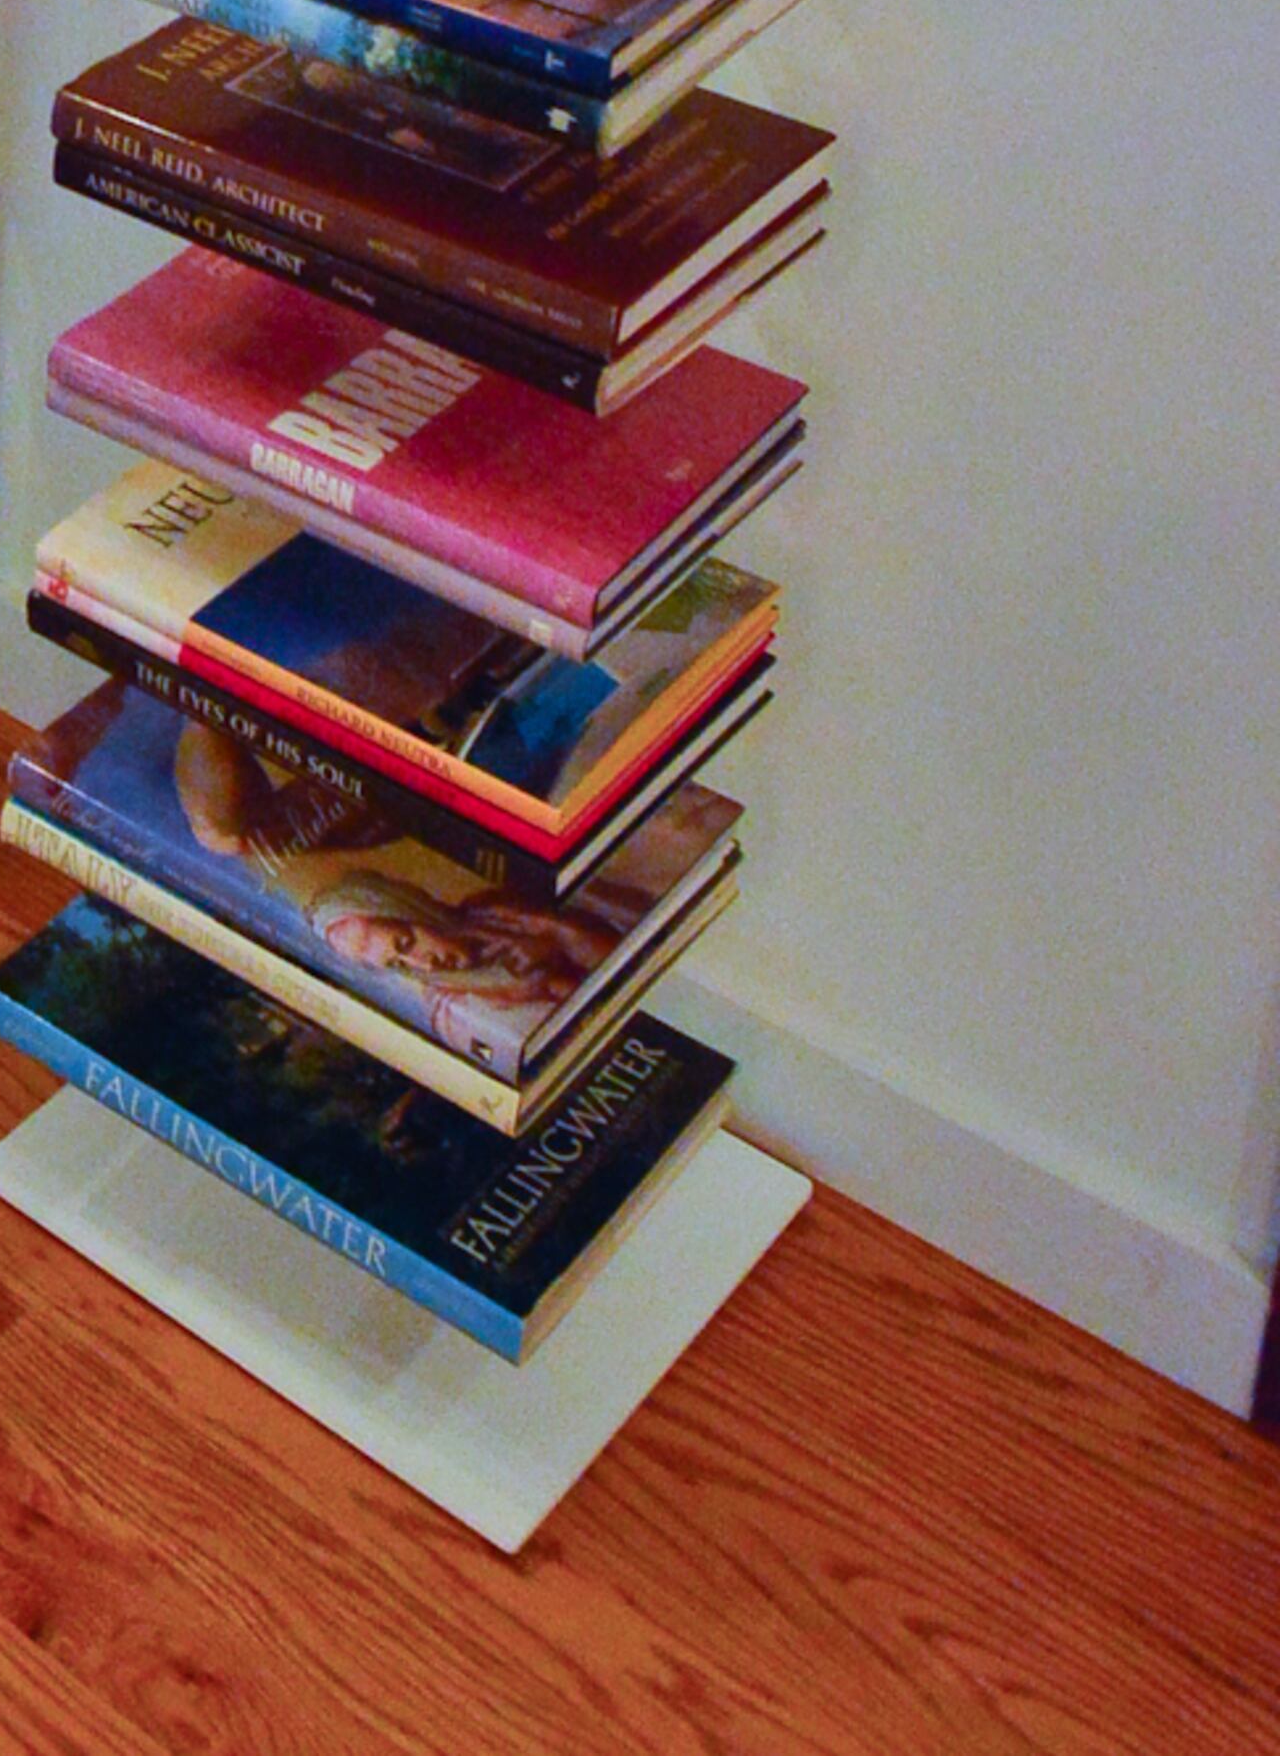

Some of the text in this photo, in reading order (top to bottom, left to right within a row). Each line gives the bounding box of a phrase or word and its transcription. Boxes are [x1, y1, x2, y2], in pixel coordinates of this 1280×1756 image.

[85, 172, 190, 229] AMERICAN
[192, 216, 307, 276] CLASSICIST
[94, 123, 143, 161] NEEL
[213, 175, 327, 233] ARCHITECT
[134, 661, 366, 800] THE EYES OF HIS SOUL
[296, 685, 455, 779] RICHARD NEUTRA
[83, 1060, 390, 1279] FALLINGWATER
[450, 1036, 667, 1265] FALLINGWATER
